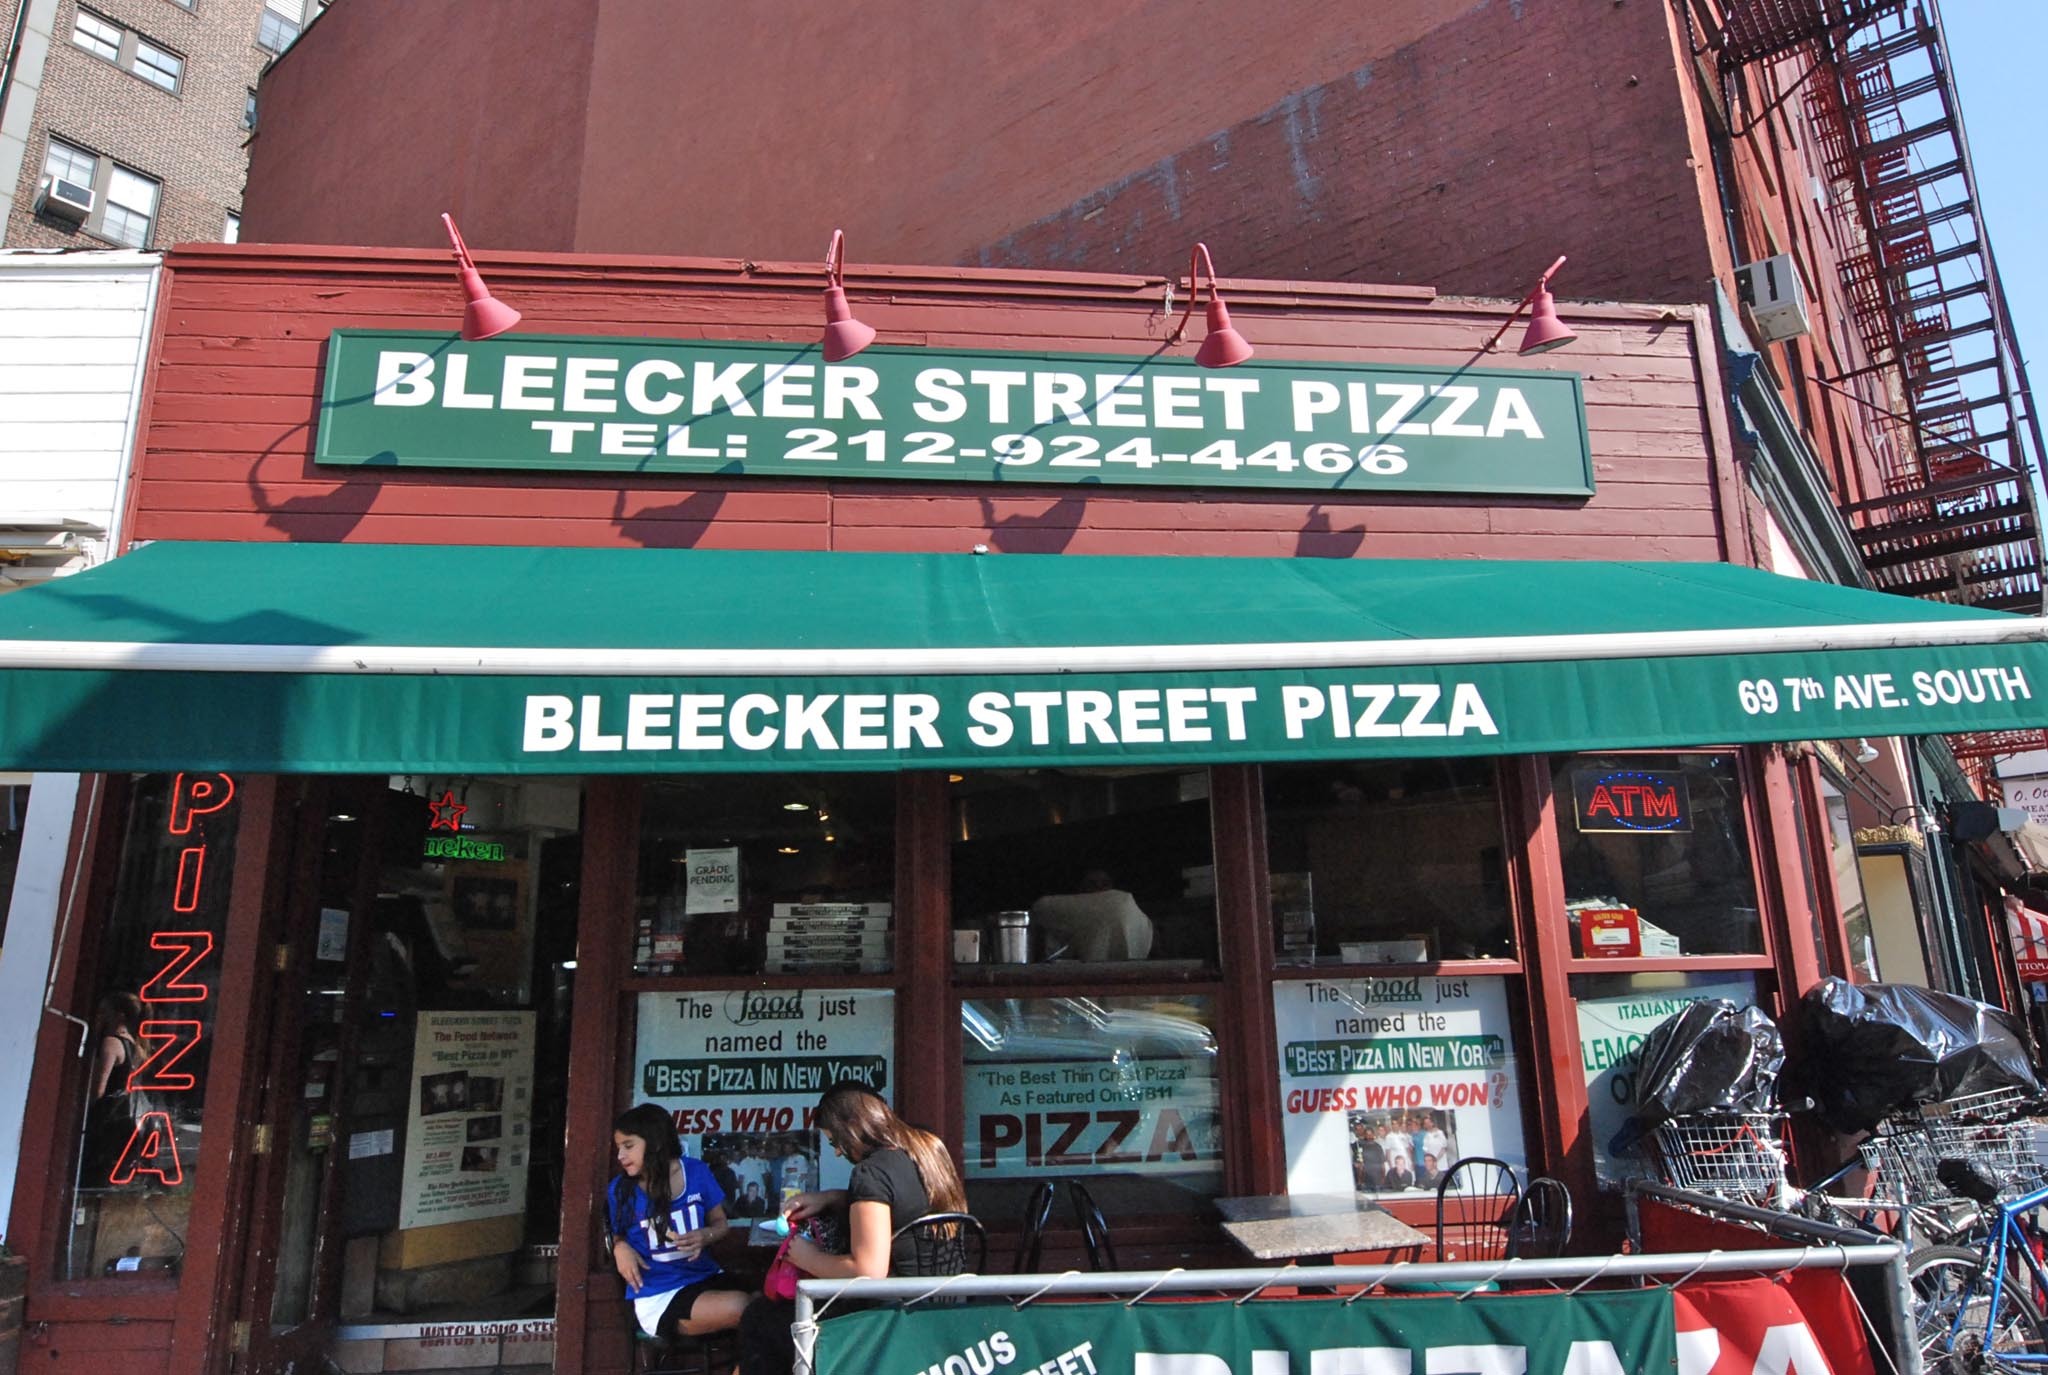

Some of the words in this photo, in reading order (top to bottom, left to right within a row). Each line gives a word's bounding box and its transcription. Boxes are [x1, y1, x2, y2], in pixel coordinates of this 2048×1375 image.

[374, 350, 883, 421] BLEECKER
[912, 368, 1260, 431] STREET
[1292, 380, 1544, 439] PIZZA
[531, 421, 747, 457] TEL:
[783, 427, 1409, 475] 212-924-4466
[1738, 678, 1778, 715] 69
[1783, 676, 1825, 712] 7th
[1834, 673, 1909, 710] AVE.
[1912, 666, 2031, 706] SOUTH
[523, 694, 943, 752] BLEECKER
[967, 686, 1257, 747] STREET
[1282, 683, 1499, 739] PIZZA
[1587, 785, 1678, 817] ATM
[424, 835, 504, 861] neken
[690, 874, 735, 885] PENDING
[695, 864, 729, 876] GRADE
[111, 773, 235, 1185] PIZZA
[1306, 983, 1339, 1003] The
[1435, 979, 1470, 999] just
[676, 998, 713, 1019] The
[818, 995, 856, 1021] just
[1618, 999, 1676, 1020] ITALIAN
[1336, 1012, 1405, 1035] named
[1418, 1011, 1446, 1032] the
[705, 1030, 783, 1052] named
[796, 1029, 827, 1051] the
[1581, 1034, 1648, 1071] LEMO
[1341, 1045, 1384, 1071] PIZZA
[1388, 1043, 1403, 1069] IN
[1409, 1042, 1444, 1069] NEW
[707, 1064, 754, 1091] PIZZA
[761, 1063, 778, 1089] IN
[783, 1062, 822, 1089] NEW
[1020, 1070, 1057, 1085] Best
[1062, 1068, 1095, 1084] Thin
[1000, 1091, 1022, 1106] As
[1025, 1088, 1095, 1105] Featured
[1101, 1088, 1123, 1103] On
[1287, 1086, 1357, 1114] GUESS
[1364, 1084, 1422, 1110] WHO
[731, 1107, 794, 1132] WHO
[979, 1109, 1198, 1169] PIZZA
[523, 1321, 557, 1343] STE
[917, 1331, 1016, 1375] OUS
